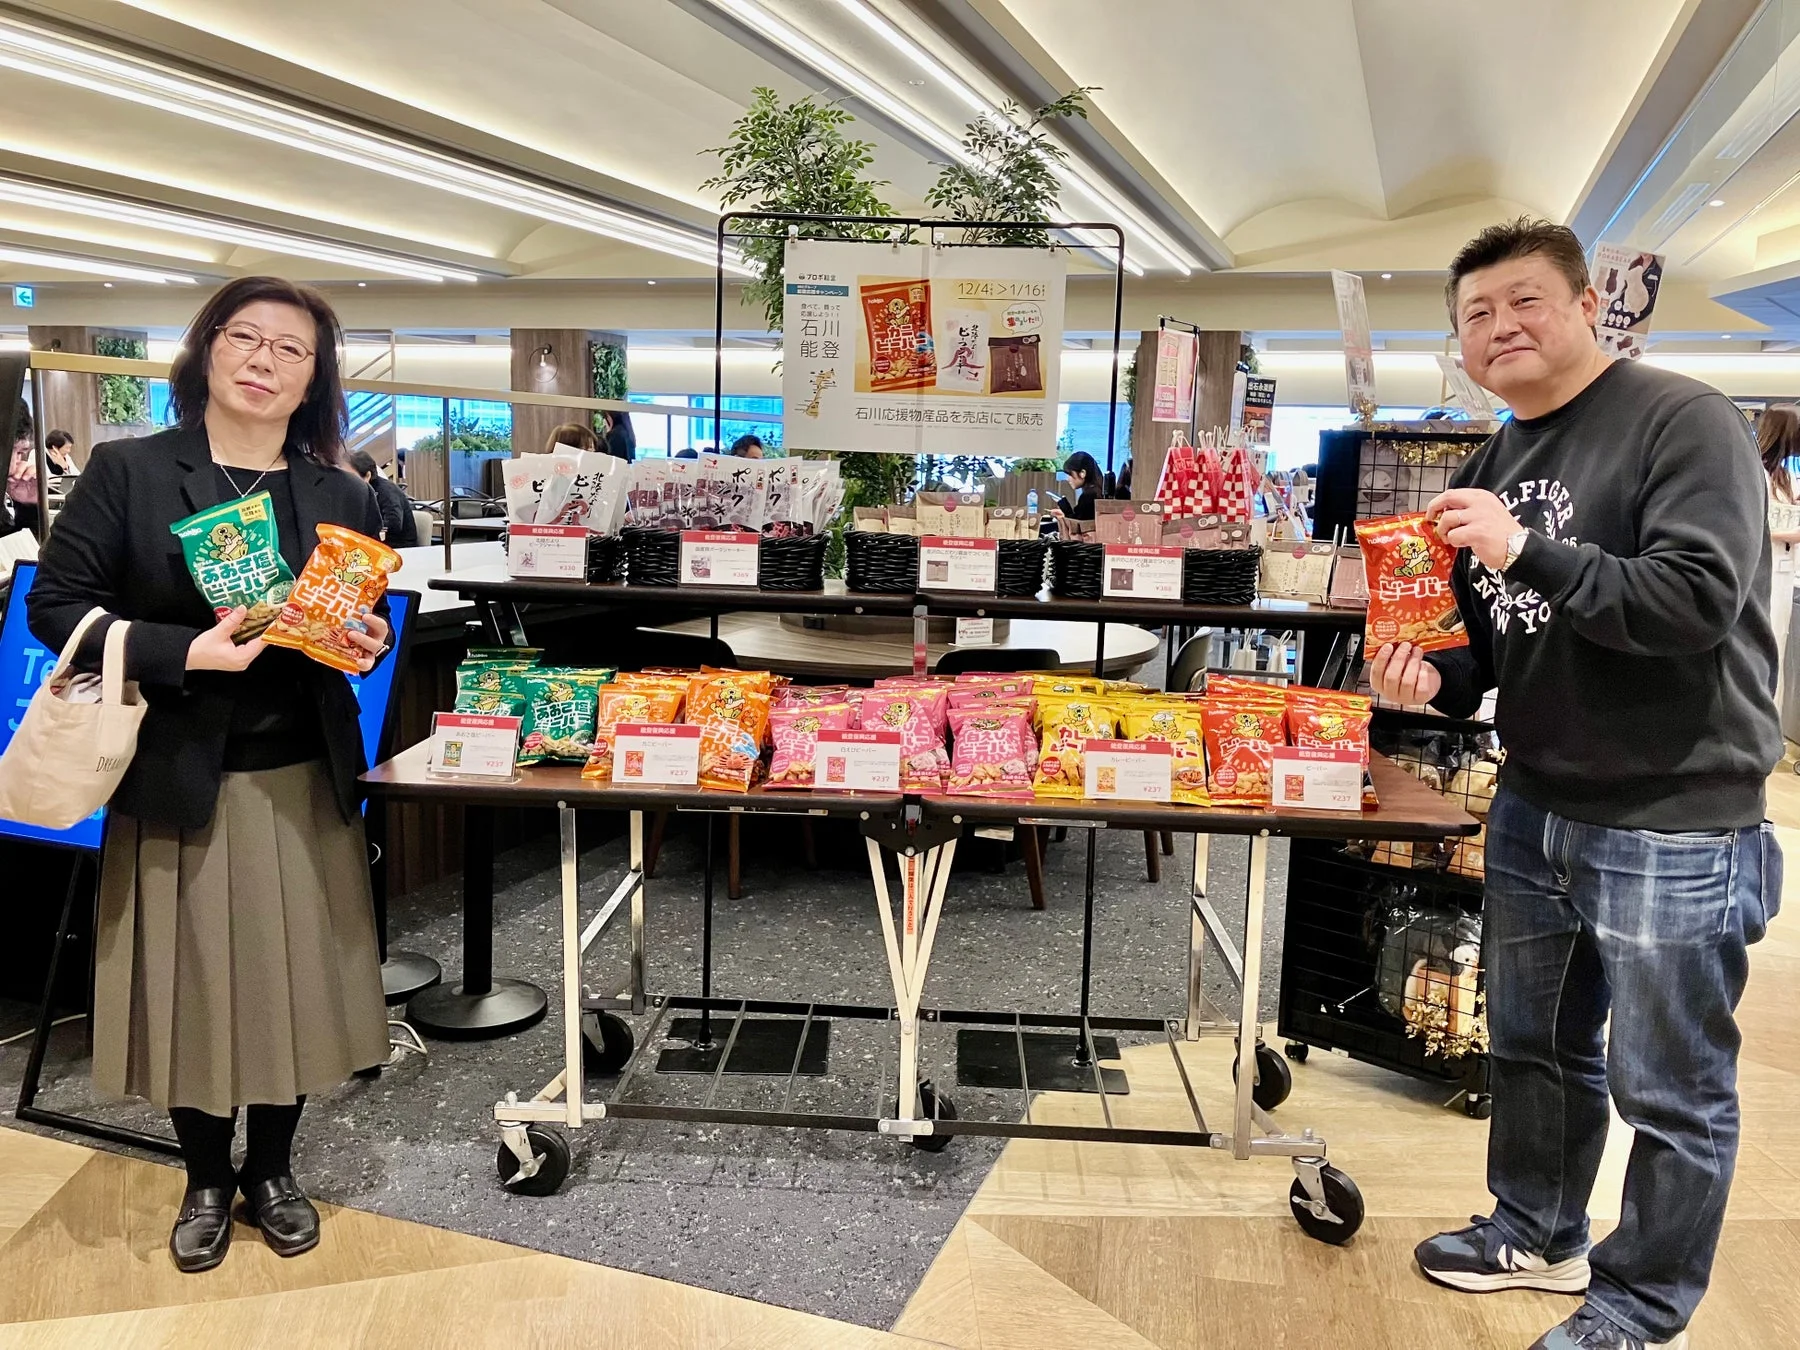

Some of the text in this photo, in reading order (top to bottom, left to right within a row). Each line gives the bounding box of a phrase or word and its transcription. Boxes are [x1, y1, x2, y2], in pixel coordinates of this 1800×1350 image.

[800, 319, 840, 337] 石川
[887, 324, 913, 339] カニ
[800, 340, 840, 359] 能登
[875, 337, 928, 353] ビーバー
[855, 407, 1043, 427] 石川応援物産品を売店にて販売
[731, 467, 752, 507] ポーク
[1500, 479, 1574, 530] LFIGER
[670, 769, 689, 777] ¥237
[871, 775, 890, 783] ¥237
[1143, 786, 1162, 794] ¥237
[1332, 795, 1351, 803] ¥237
